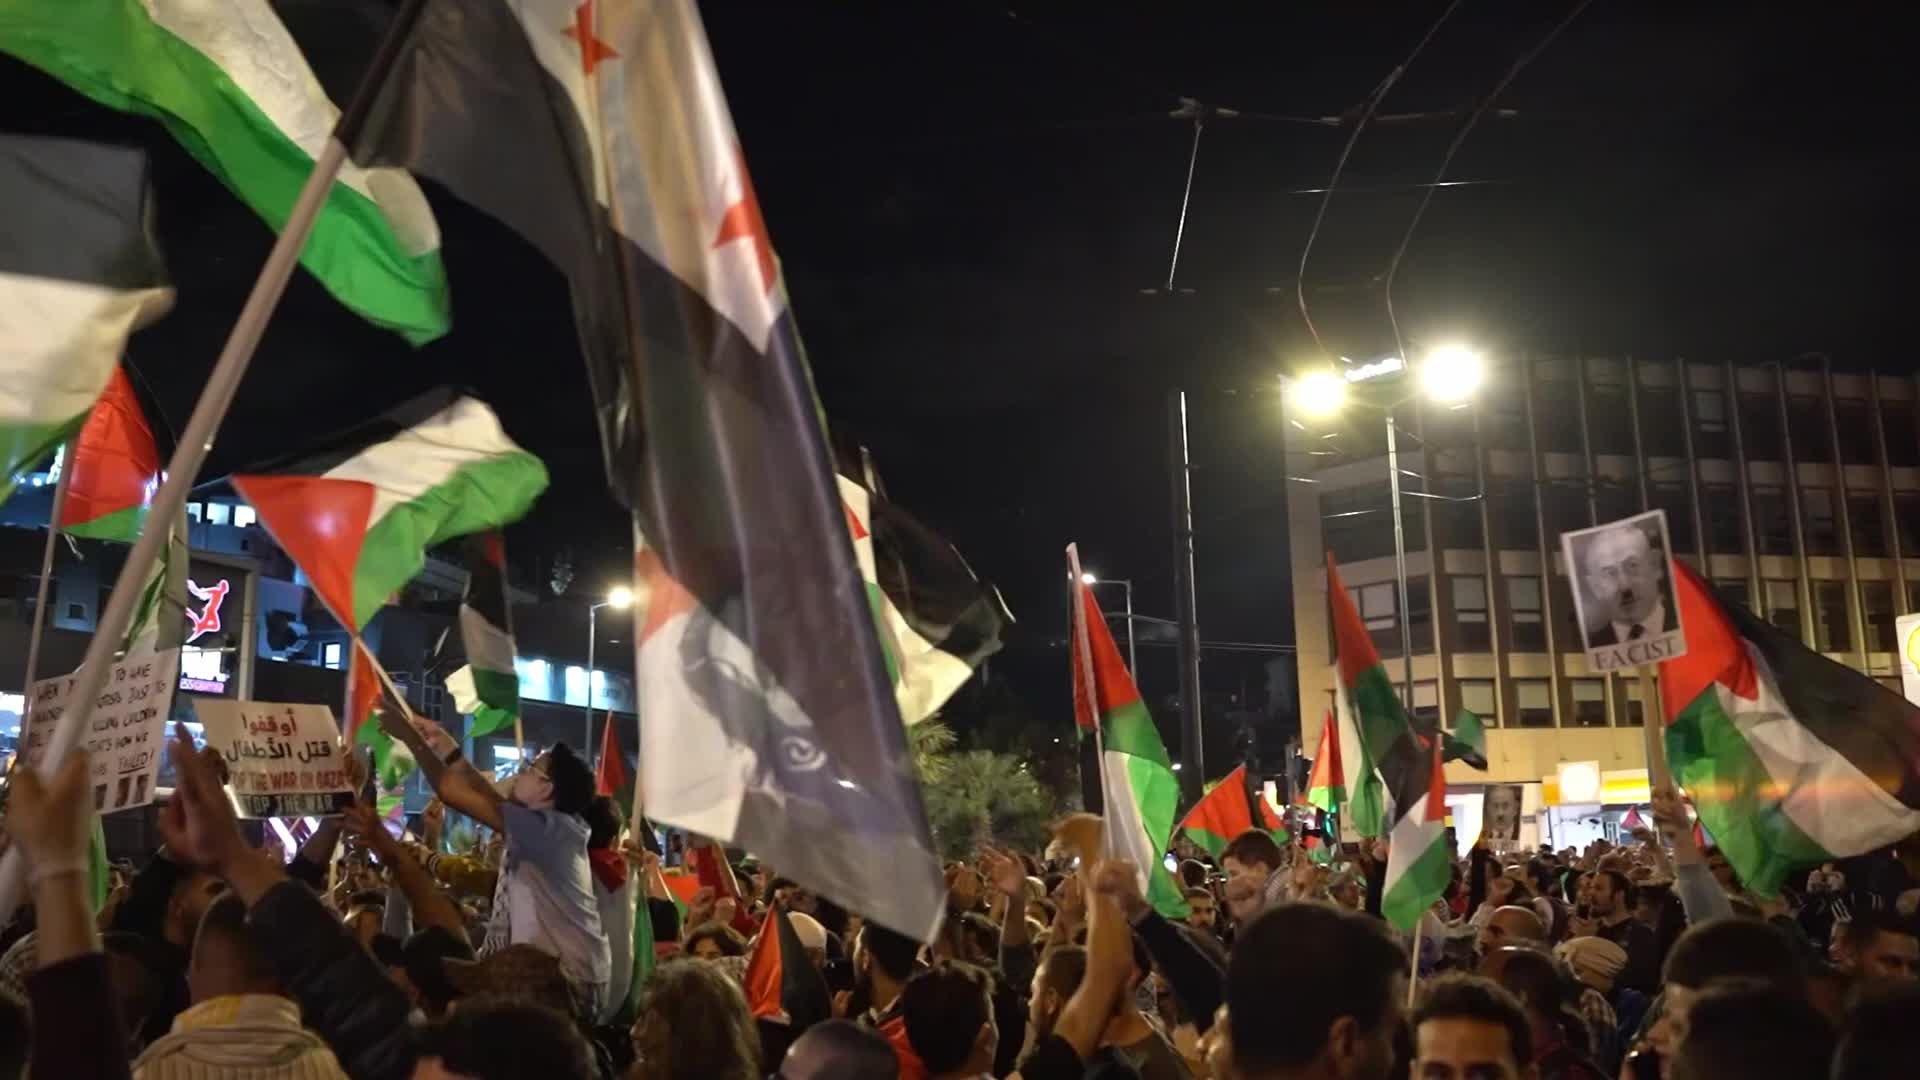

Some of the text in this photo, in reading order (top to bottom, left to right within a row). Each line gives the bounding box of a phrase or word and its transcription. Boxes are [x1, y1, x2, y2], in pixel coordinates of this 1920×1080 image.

[1595, 635, 1677, 669] FACIST
[298, 741, 332, 764] قتل
[270, 770, 296, 790] WAR
